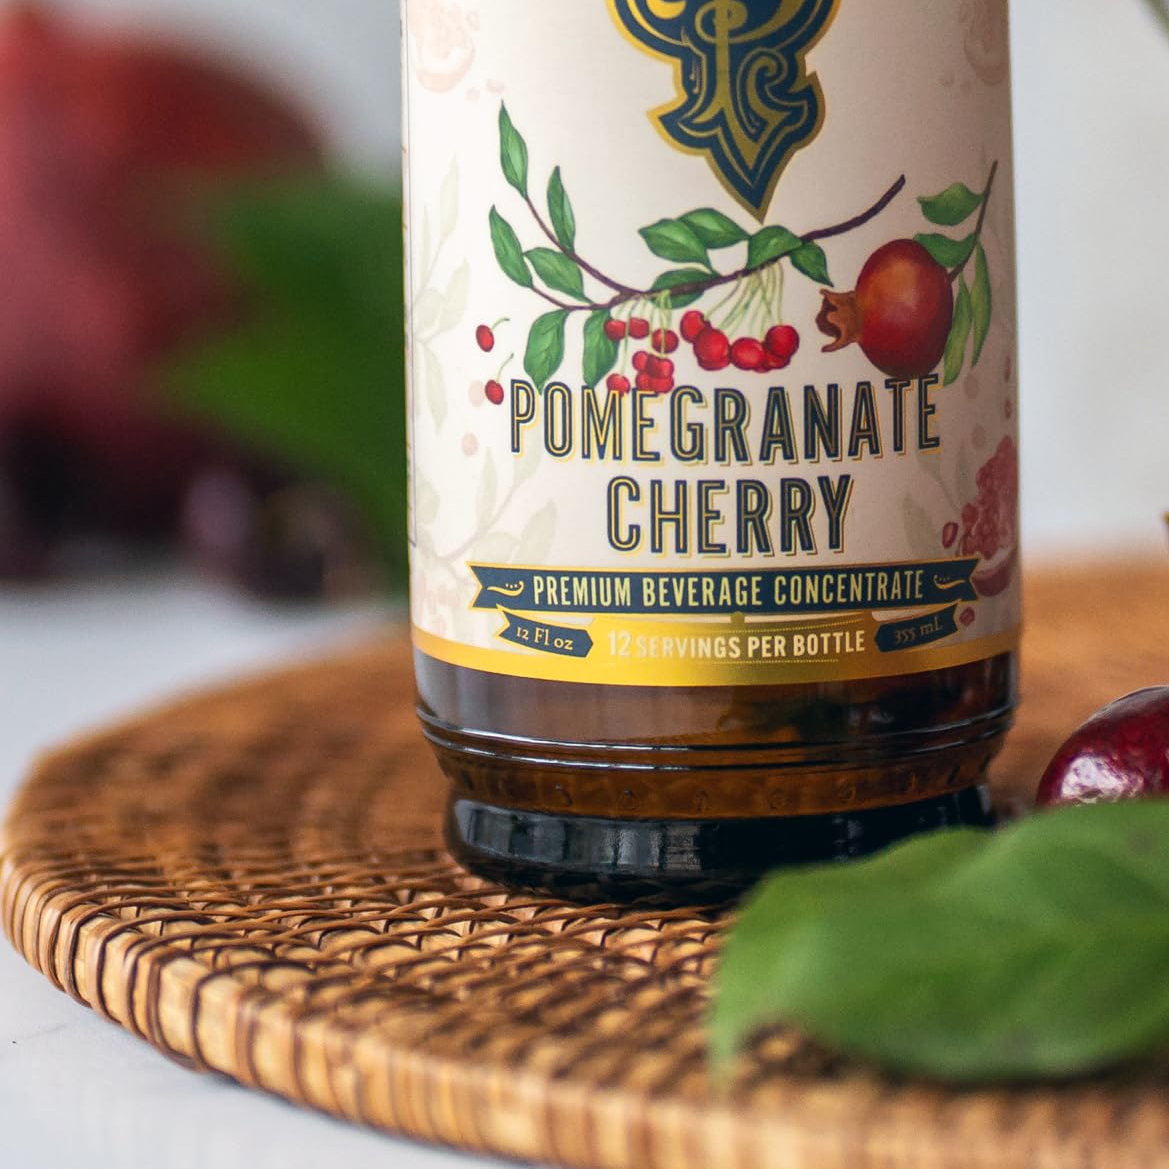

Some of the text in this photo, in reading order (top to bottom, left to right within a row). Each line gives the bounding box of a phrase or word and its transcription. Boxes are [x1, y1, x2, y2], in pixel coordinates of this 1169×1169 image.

[510, 374, 945, 465] POMEGRANATE
[606, 474, 855, 558] CHERRY
[532, 569, 925, 607] PREMIUM BEVERAGE CONCENTRATE
[515, 625, 574, 652] 12 Fl oz
[608, 630, 866, 659] 12 SERVINGS PER BOTTLE
